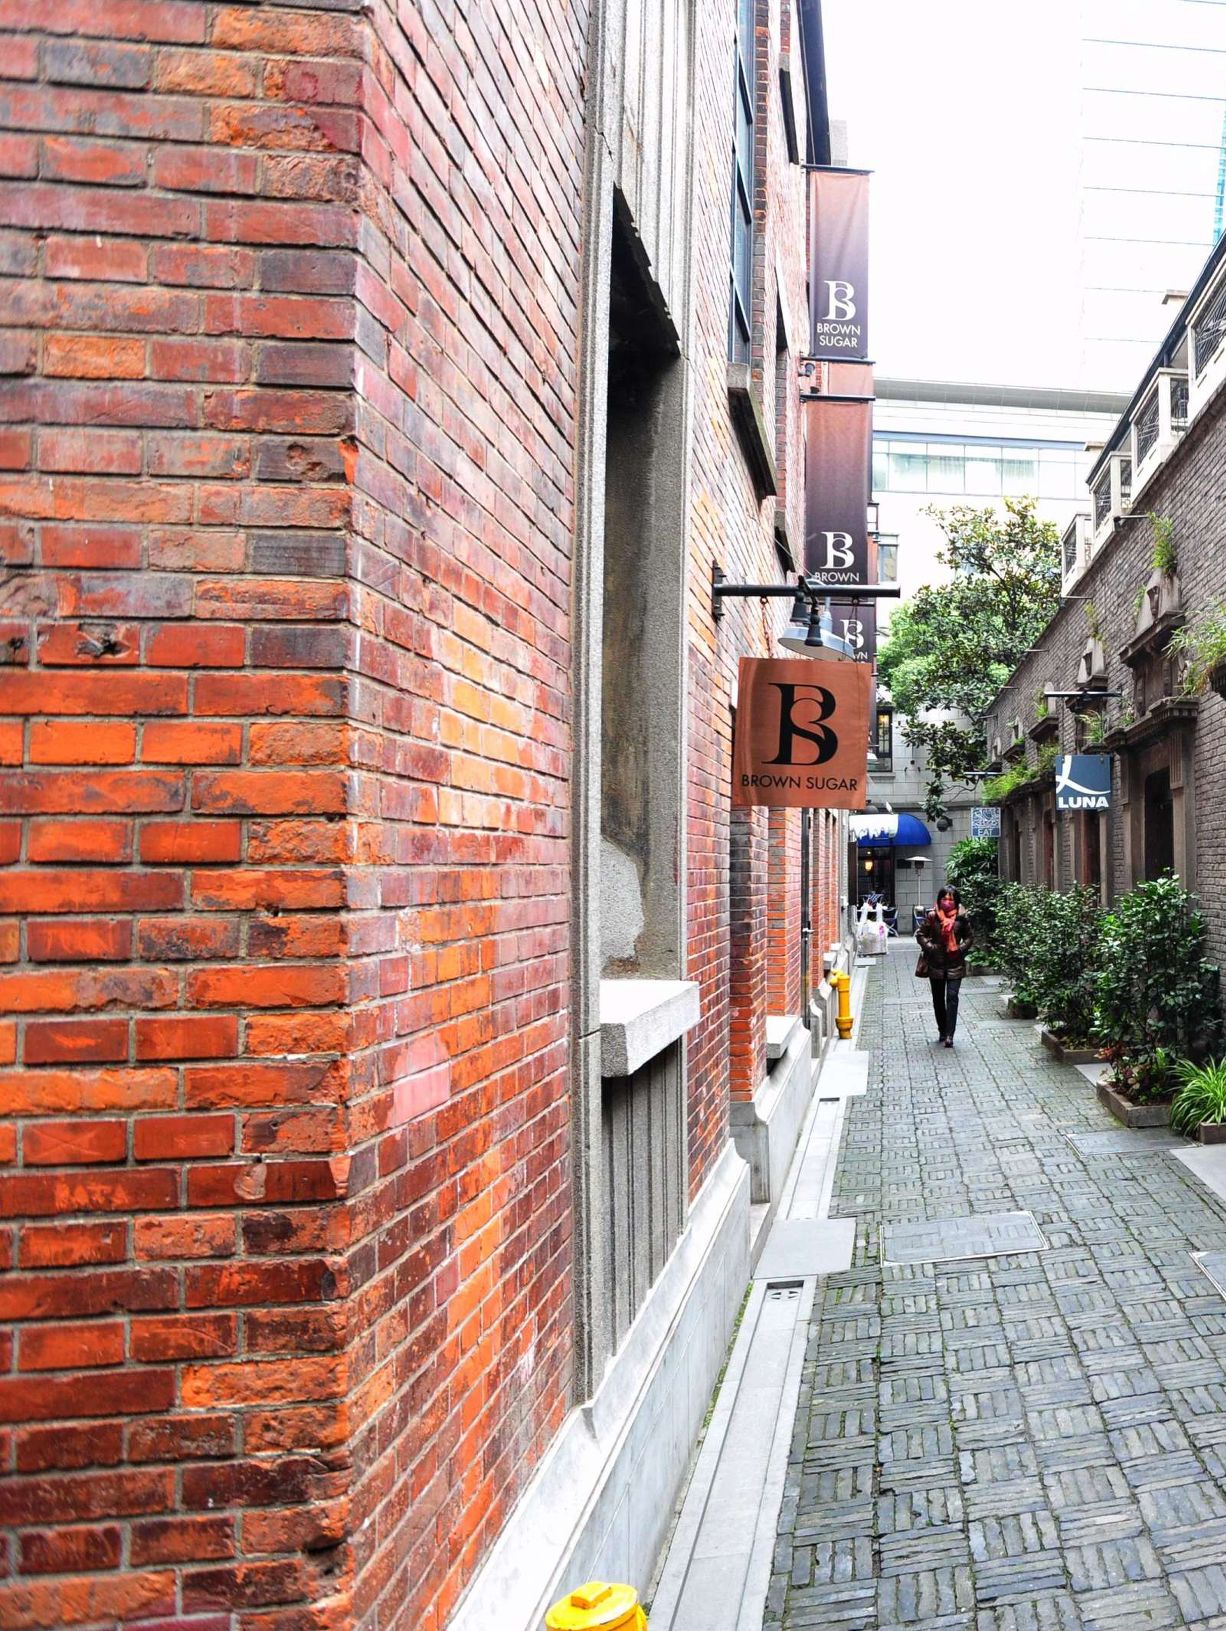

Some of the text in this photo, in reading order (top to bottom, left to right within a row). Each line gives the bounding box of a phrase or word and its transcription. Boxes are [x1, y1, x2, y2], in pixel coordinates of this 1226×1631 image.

[816, 323, 861, 336] BROWN
[819, 335, 858, 348] SUGAR
[814, 571, 860, 582] BROWN
[741, 774, 858, 792] BROWN SUGAR
[1058, 796, 1110, 809] LUNA
